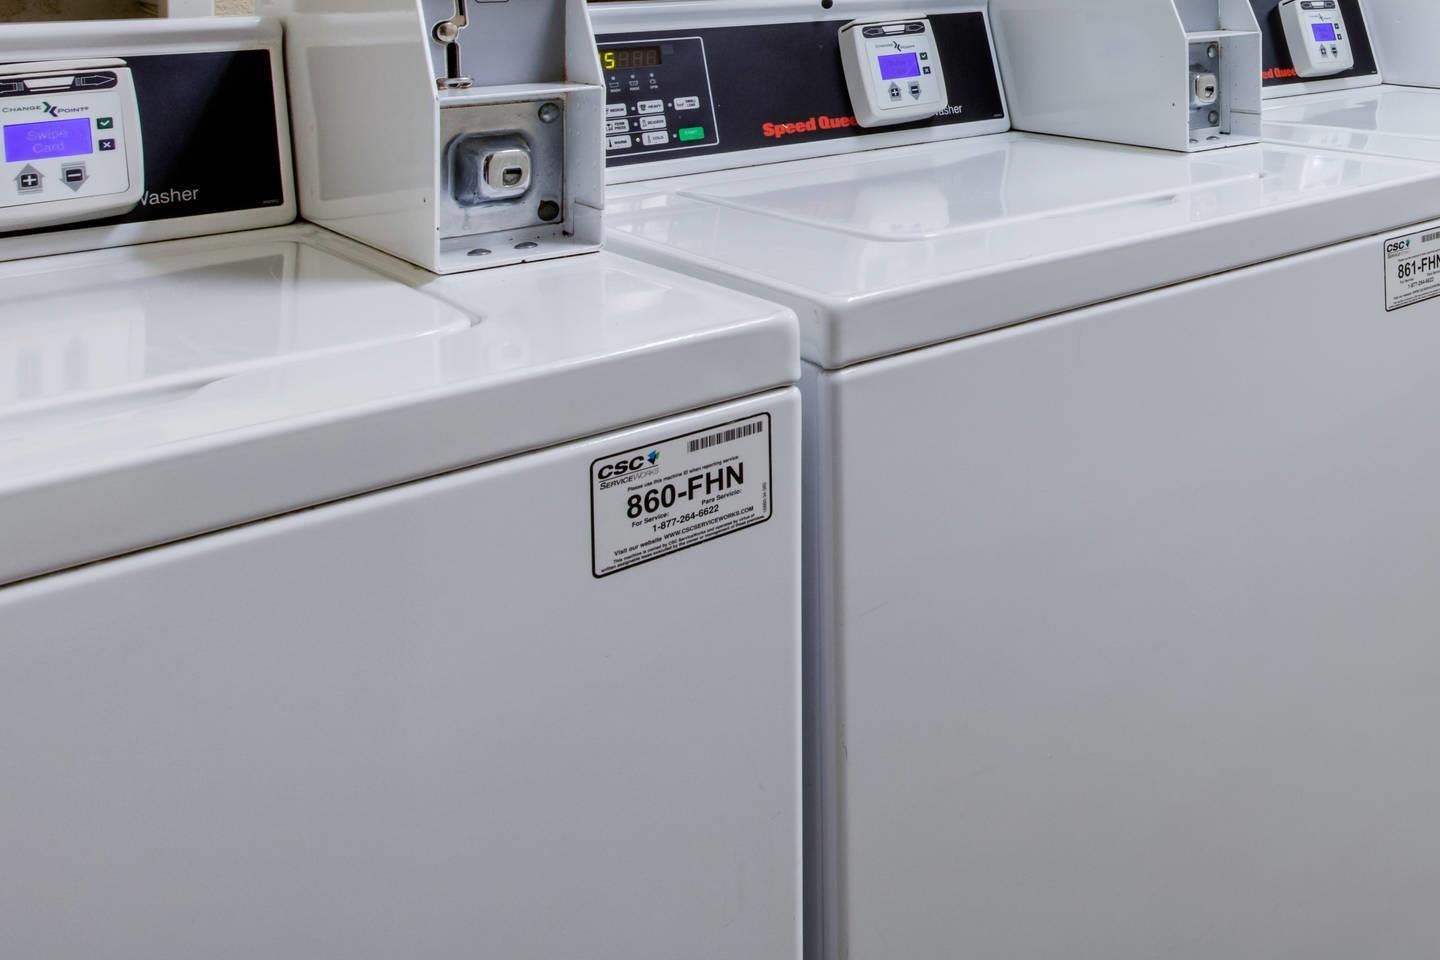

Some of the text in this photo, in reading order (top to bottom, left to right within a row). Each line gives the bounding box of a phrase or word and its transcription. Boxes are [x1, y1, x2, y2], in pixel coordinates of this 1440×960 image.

[2, 105, 42, 113] CHANGE
[935, 105, 962, 116] asher
[762, 115, 858, 138] Speed Quee
[32, 142, 64, 153] Card
[1387, 241, 1405, 253] CSC
[598, 456, 644, 479] CSC
[627, 463, 743, 518] 860-FHN
[653, 504, 719, 531] 1-877-264-6622
[614, 548, 627, 556] Visit
[640, 537, 662, 547] website
[664, 506, 753, 539] WWW.CSCSERVICEWORKS.COM
